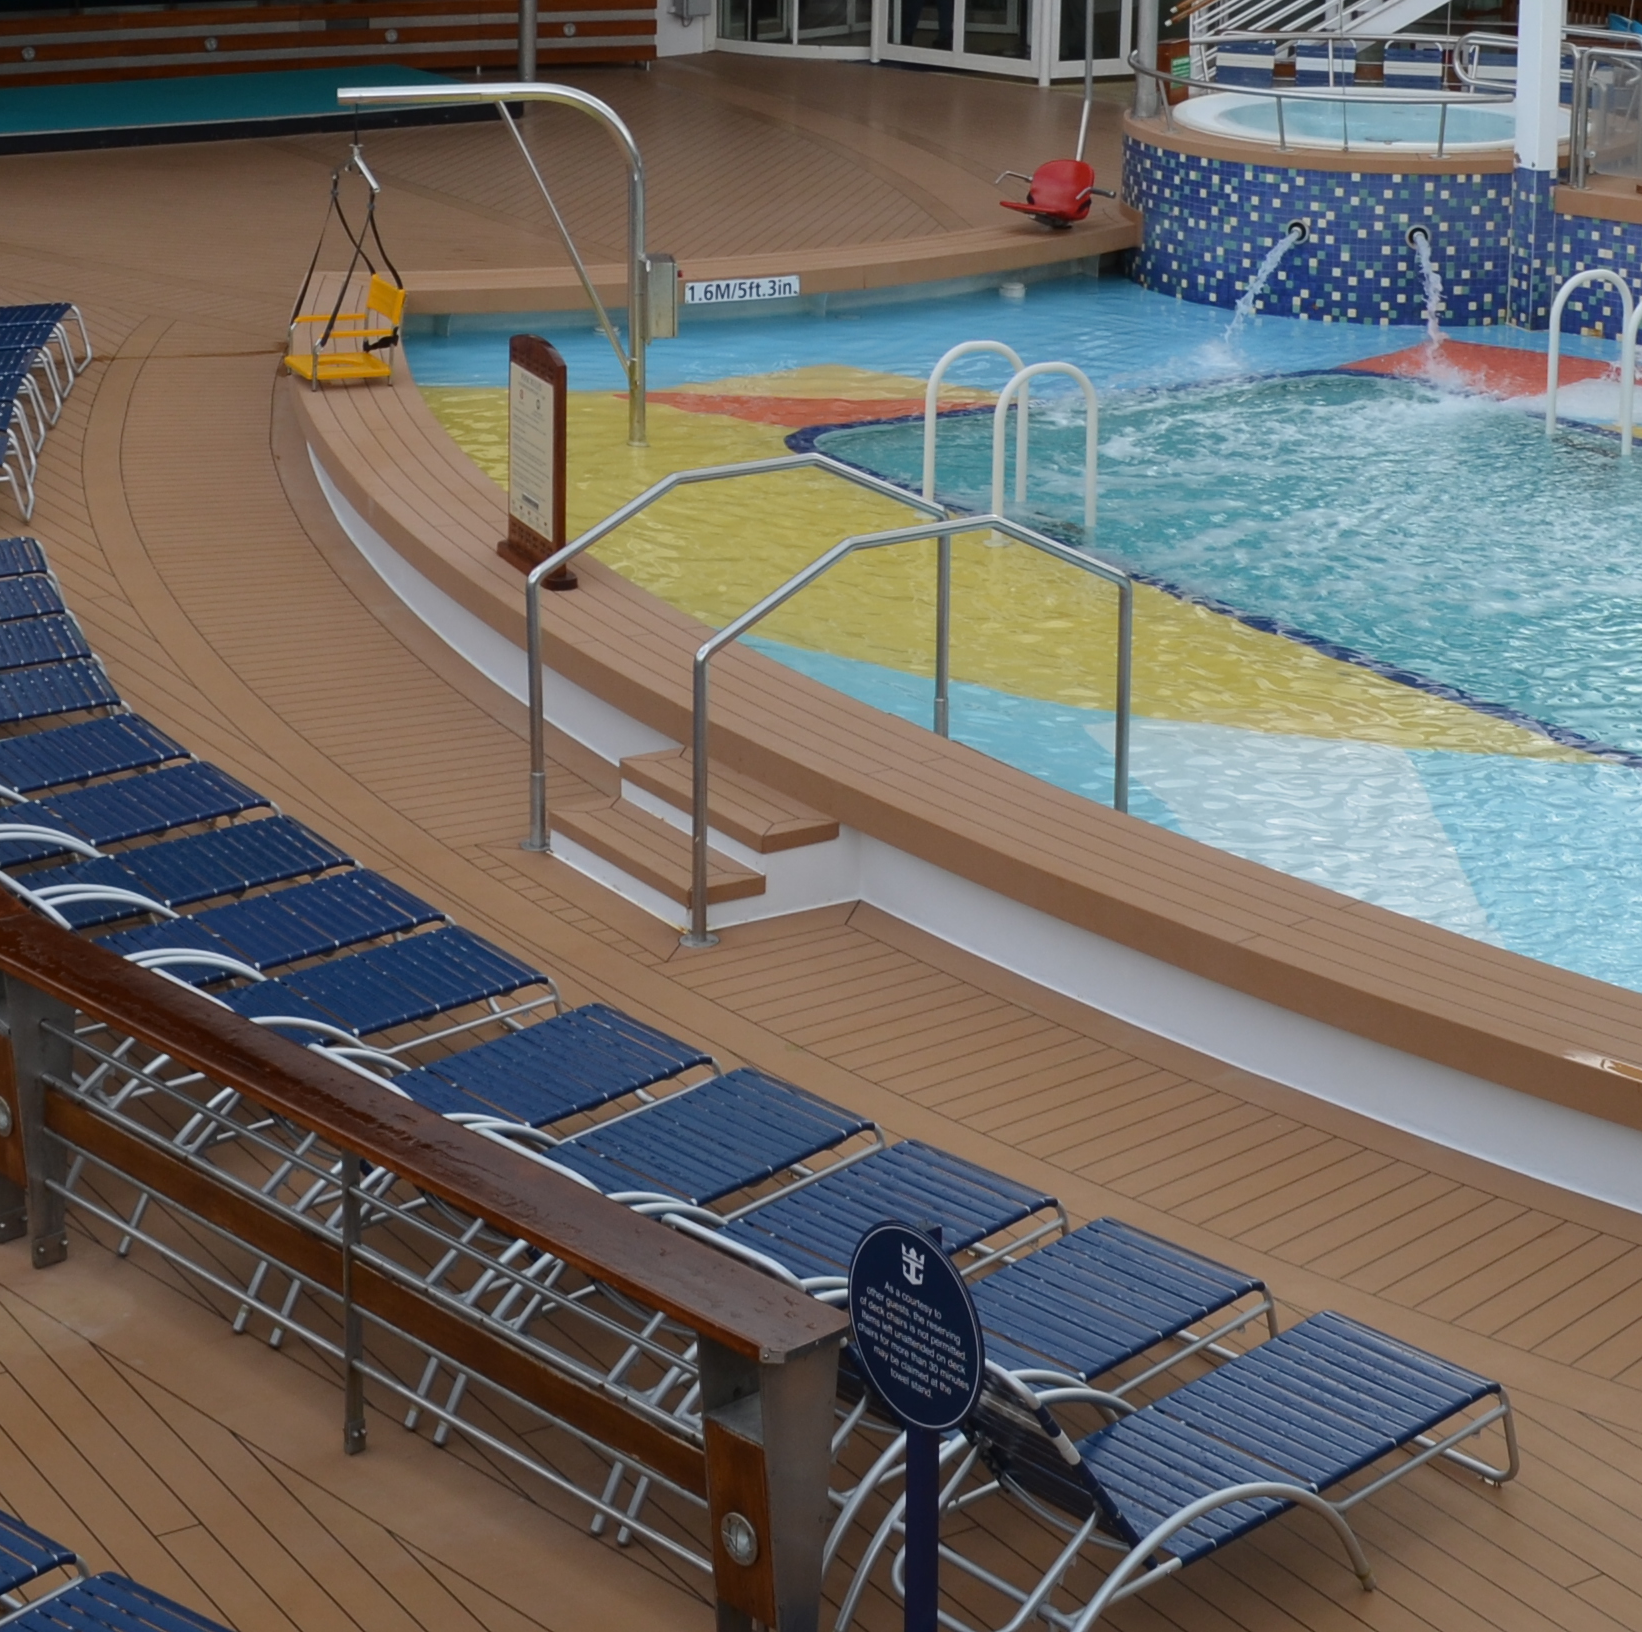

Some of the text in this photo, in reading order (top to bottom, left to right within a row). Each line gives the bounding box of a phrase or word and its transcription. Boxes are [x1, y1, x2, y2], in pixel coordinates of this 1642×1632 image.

[688, 279, 798, 302] 1.6M/5ft.3in.
[867, 1287, 961, 1347] other guests, the reserving
[884, 1281, 942, 1320] As a courtesy to
[860, 1297, 968, 1362] of deck chairs is not permitted.
[861, 1310, 966, 1376] Items left unattended on deck
[858, 1323, 970, 1391] chairs for more than 30 minutes
[874, 1346, 952, 1395] may be claimed at the
[891, 1368, 933, 1399] towel stand.
